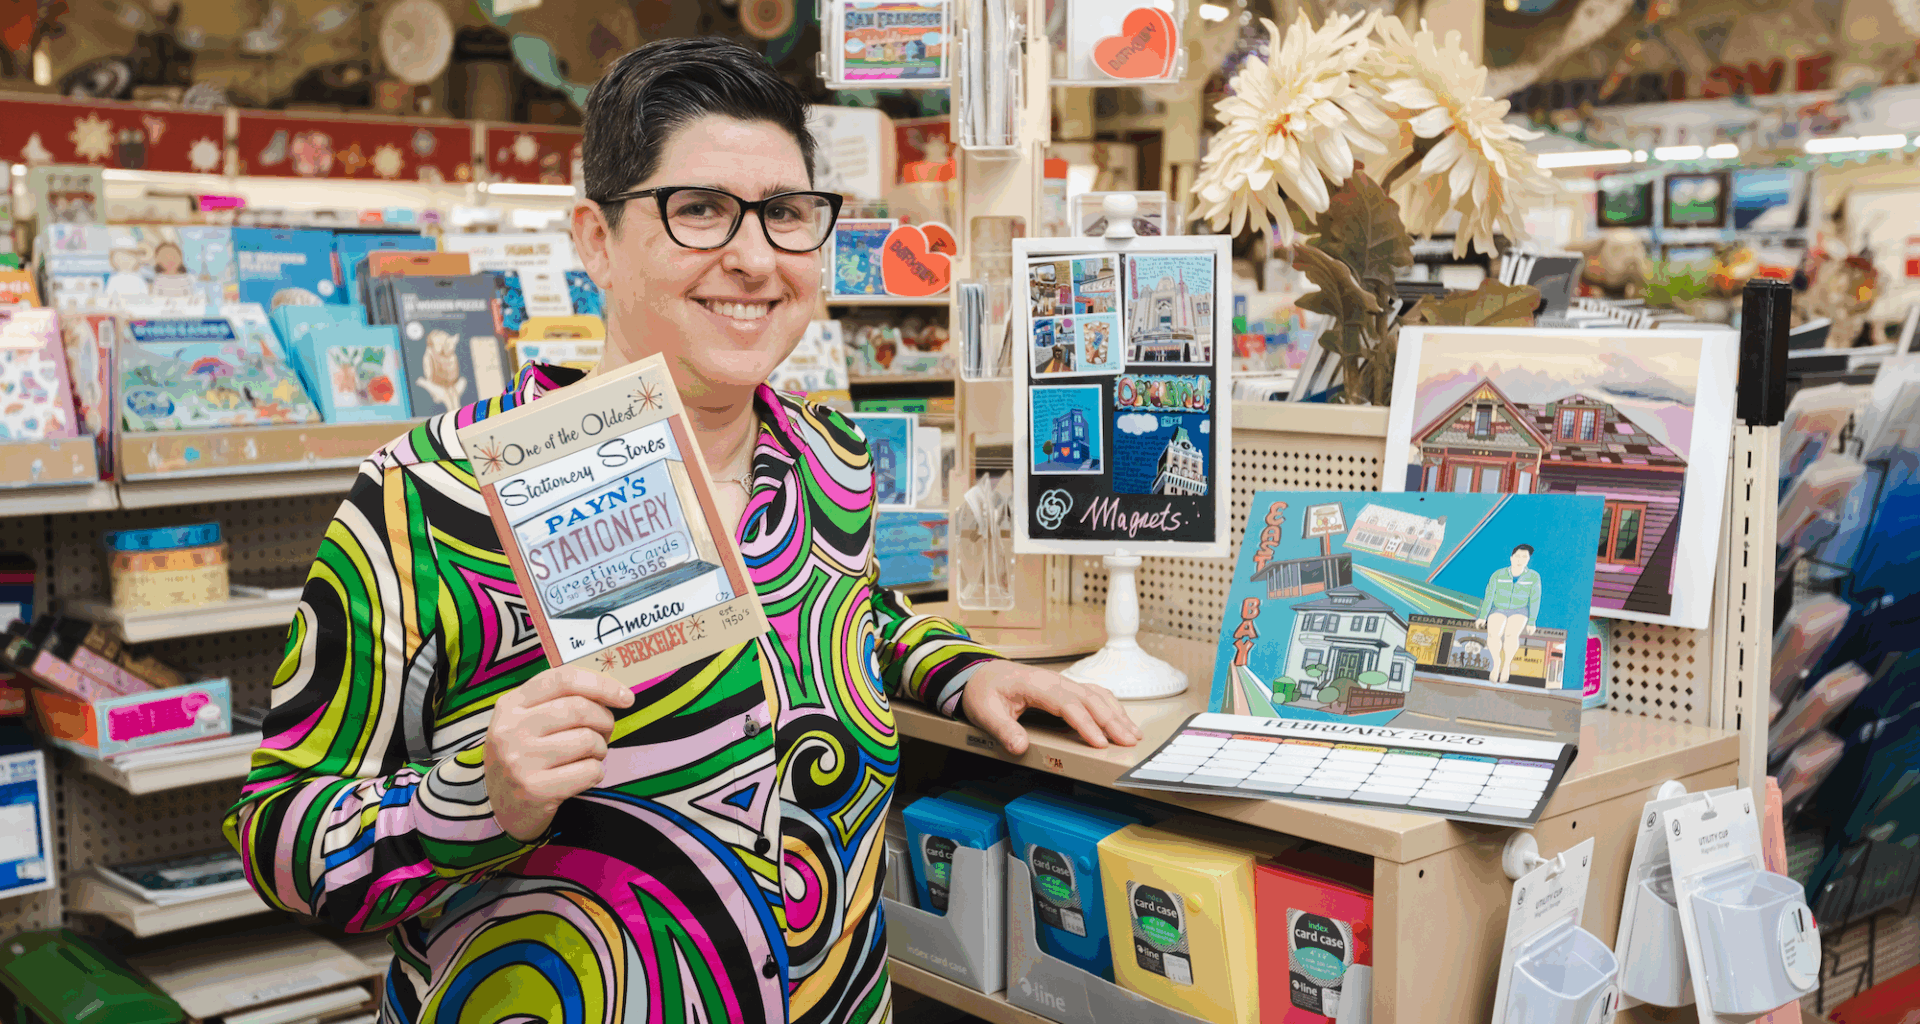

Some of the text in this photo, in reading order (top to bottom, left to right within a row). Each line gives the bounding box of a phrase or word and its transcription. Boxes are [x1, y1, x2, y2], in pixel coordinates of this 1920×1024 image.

[502, 403, 637, 466] One of the Oldest
[499, 438, 666, 507] Stationery Stores
[545, 476, 647, 535] PAYN'S
[528, 492, 673, 581] STATIONERY
[1253, 501, 1288, 573] EAST
[629, 538, 679, 567] Cards
[585, 556, 668, 597] 526-3056
[718, 605, 737, 616] est.
[721, 608, 750, 630] 1950's
[1411, 616, 1444, 625] CEDAR
[570, 601, 685, 650] in America
[1233, 596, 1261, 667] BAY
[615, 621, 689, 669] BERKELEY
[1263, 718, 1486, 746] FEBRUARY 2026
[1458, 754, 1482, 763] Friday
[1698, 829, 1729, 846] UTILITY CUP
[927, 847, 945, 858] card
[1033, 859, 1070, 877] card case
[1135, 899, 1178, 918] card case
[1295, 928, 1344, 949] card case
[1308, 920, 1329, 933] index
[929, 953, 948, 967] card
[949, 961, 968, 975] case
